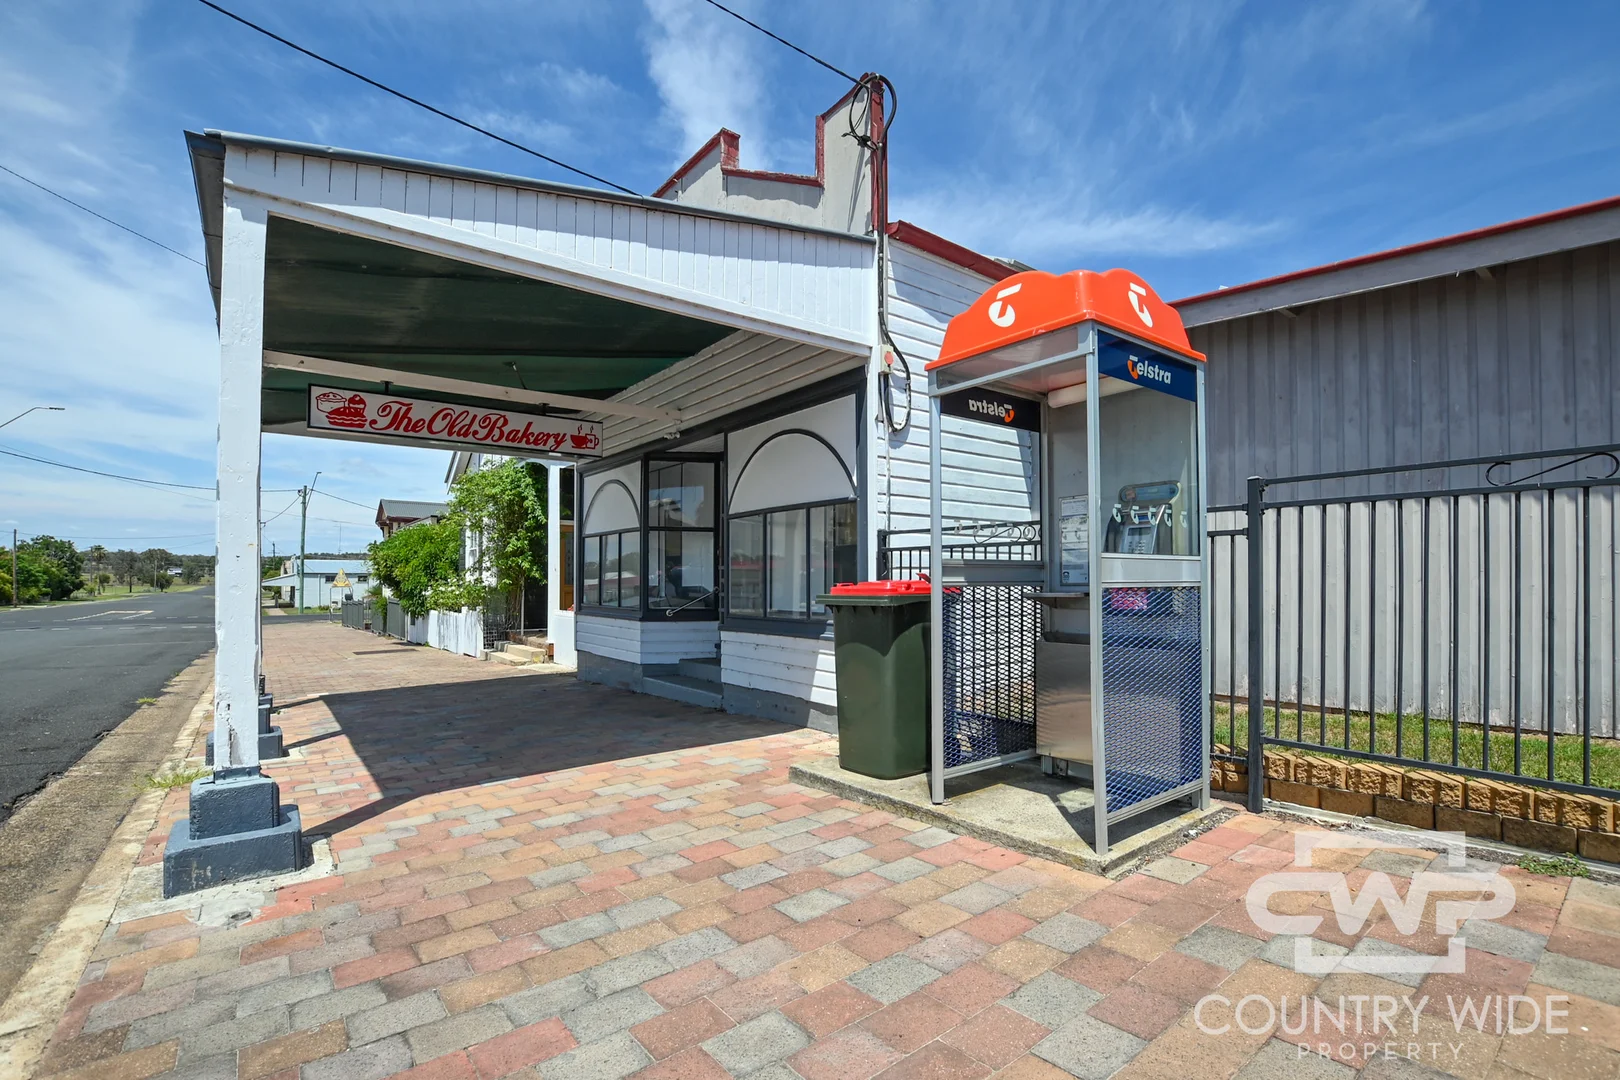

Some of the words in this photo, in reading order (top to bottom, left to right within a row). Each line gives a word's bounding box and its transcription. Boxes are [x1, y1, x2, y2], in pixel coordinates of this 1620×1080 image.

[1127, 355, 1171, 384] Telstra
[369, 401, 425, 433] The
[427, 407, 477, 438] Old
[472, 413, 567, 451] Bakery
